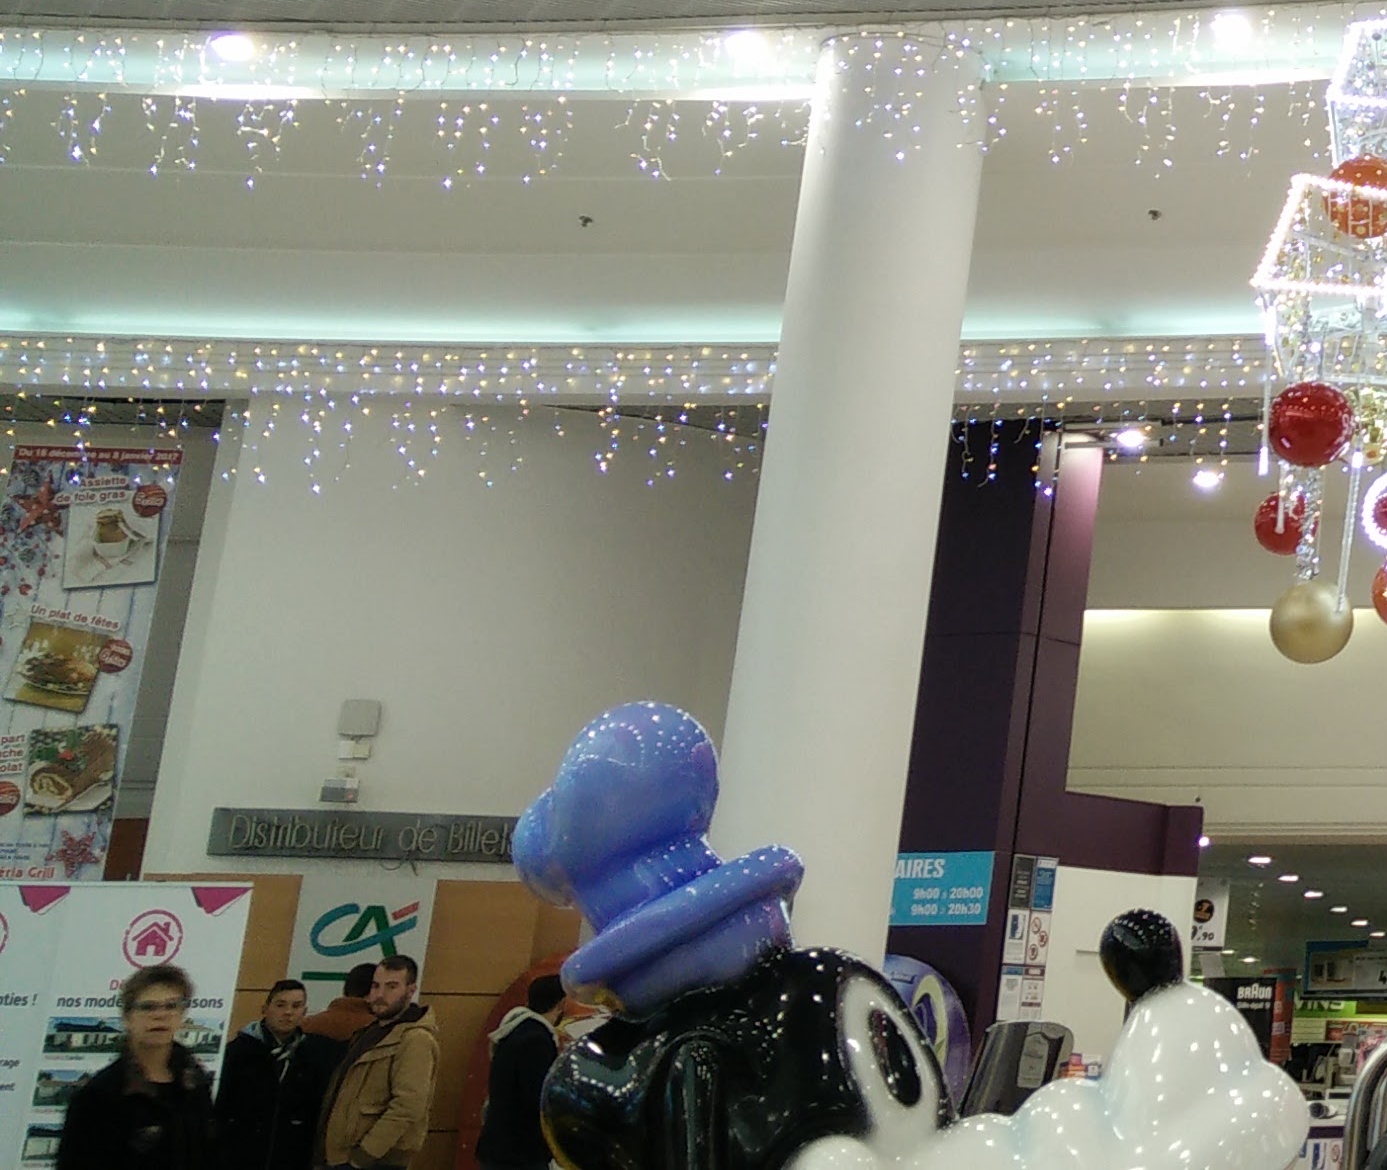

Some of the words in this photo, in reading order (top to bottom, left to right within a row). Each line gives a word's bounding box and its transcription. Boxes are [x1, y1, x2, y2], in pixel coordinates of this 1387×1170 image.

[56, 493, 71, 503] de
[74, 491, 96, 502] foie
[99, 491, 126, 503] gras
[31, 604, 46, 616] Un
[48, 609, 71, 620] plat
[73, 613, 88, 624] de
[90, 615, 119, 630] fêtes
[0, 763, 23, 772] olat
[227, 813, 386, 851] Distributeur
[398, 820, 438, 853] de
[28, 866, 55, 879] Grill
[894, 858, 946, 879] AIRES
[949, 886, 984, 900] 20h00
[947, 902, 982, 915] 20h30
[1236, 983, 1273, 1000] BRAUN
[57, 996, 82, 1008] nos
[83, 994, 124, 1008] mode
